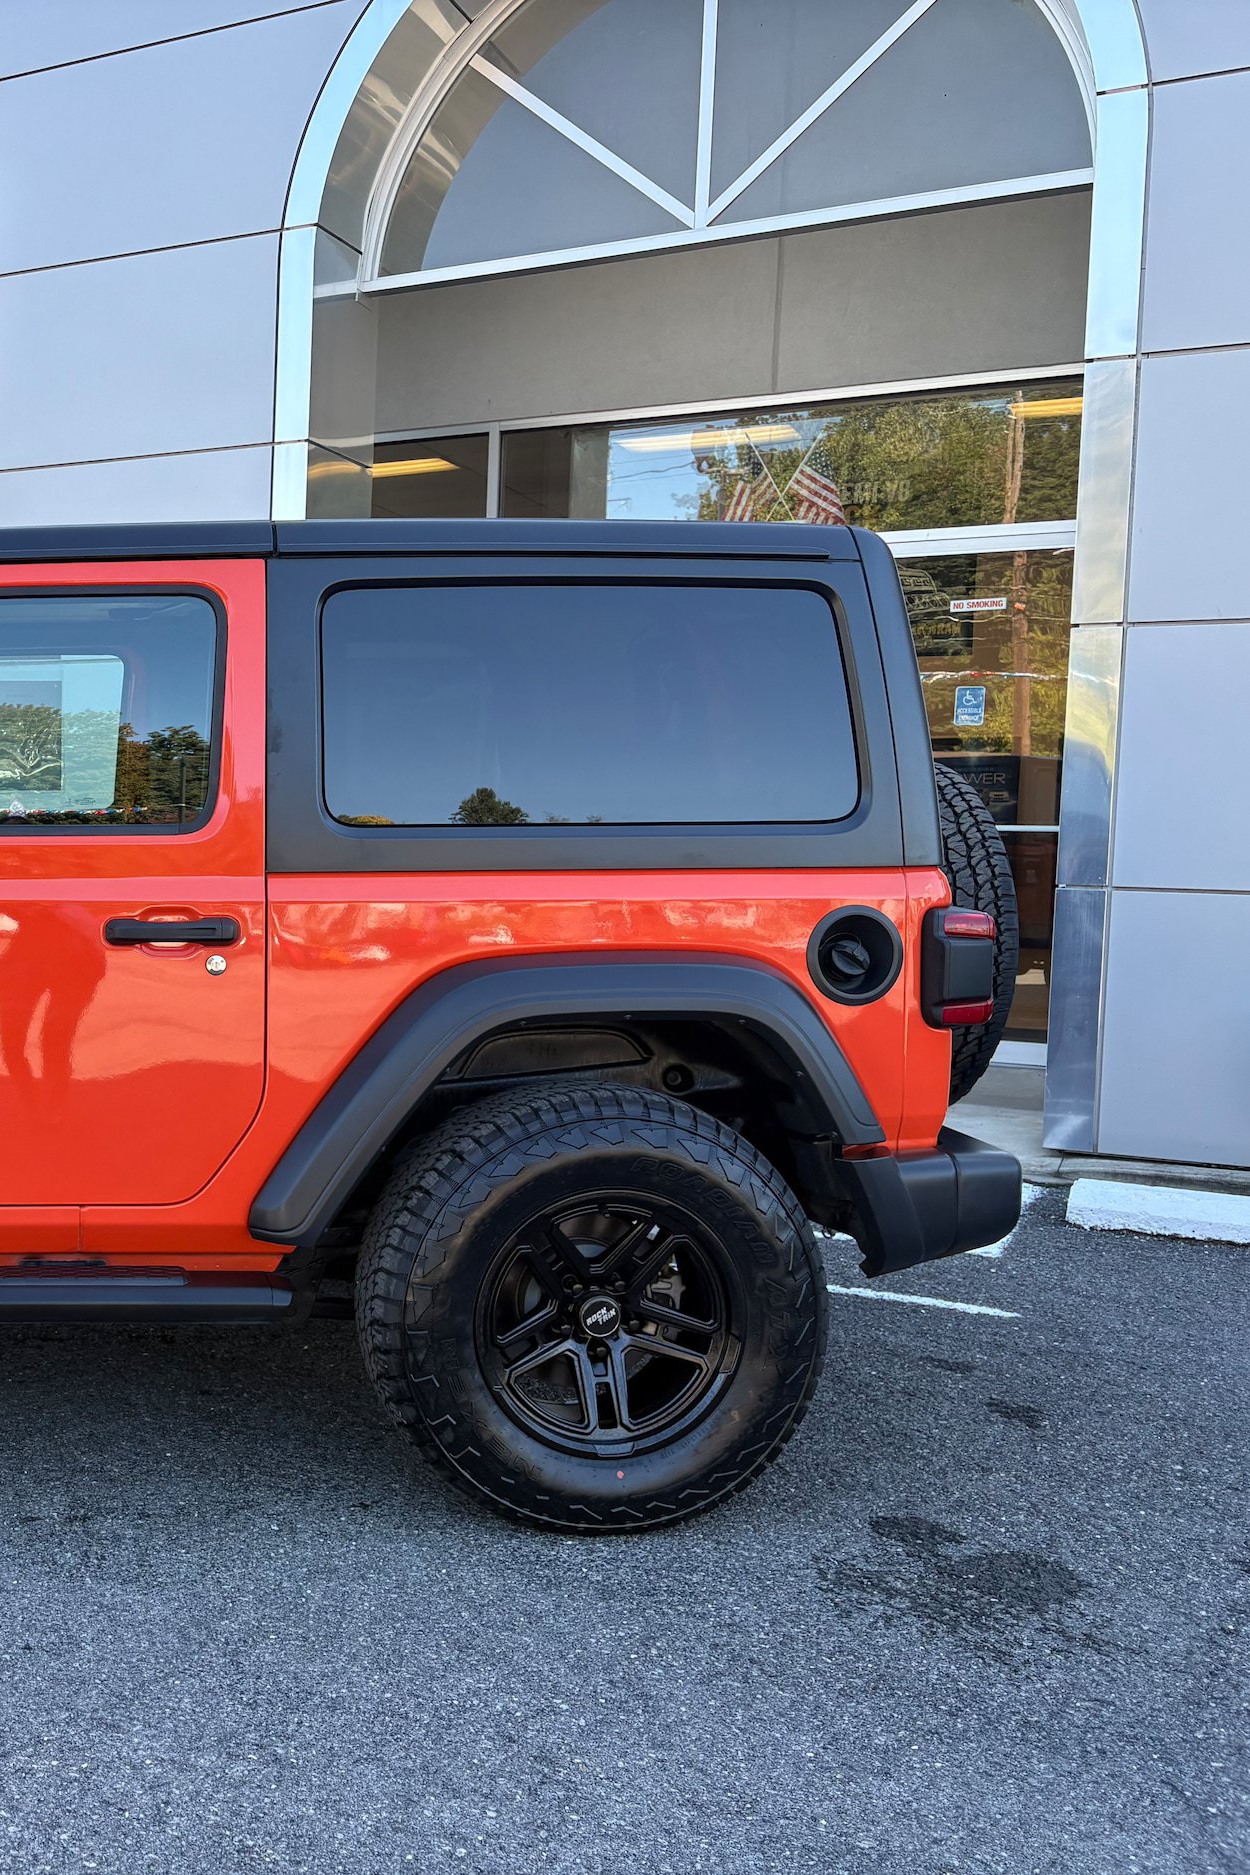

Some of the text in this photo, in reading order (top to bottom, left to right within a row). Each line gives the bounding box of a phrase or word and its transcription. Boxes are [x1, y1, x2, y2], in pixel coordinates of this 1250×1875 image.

[952, 600, 1004, 610] NO SMOKING
[586, 1307, 607, 1326] ROCK
